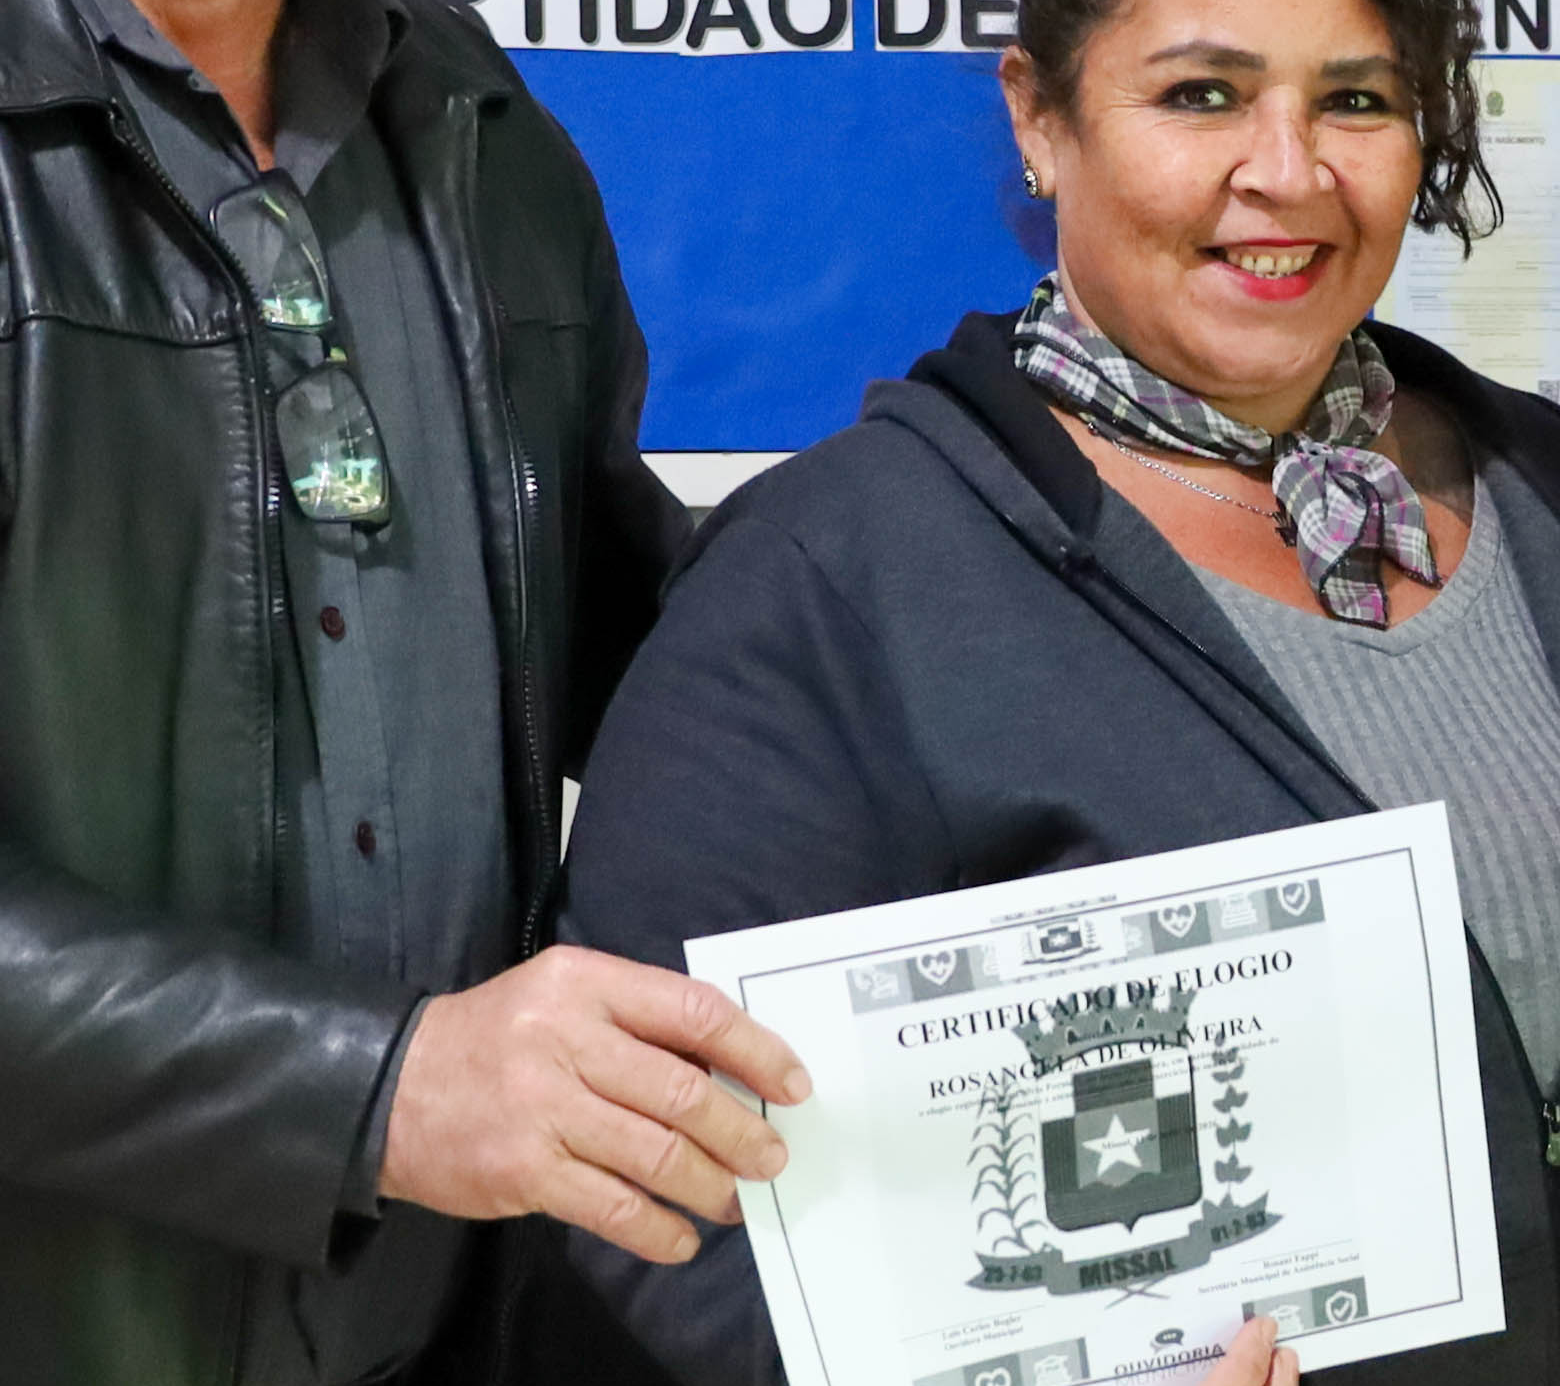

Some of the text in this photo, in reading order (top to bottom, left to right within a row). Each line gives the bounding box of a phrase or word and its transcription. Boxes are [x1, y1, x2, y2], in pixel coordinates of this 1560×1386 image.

[897, 950, 1294, 1049] CERTIFICADO DE ELOGIO
[1098, 1040, 1132, 1065] DE
[1078, 1247, 1176, 1289] MISSAL
